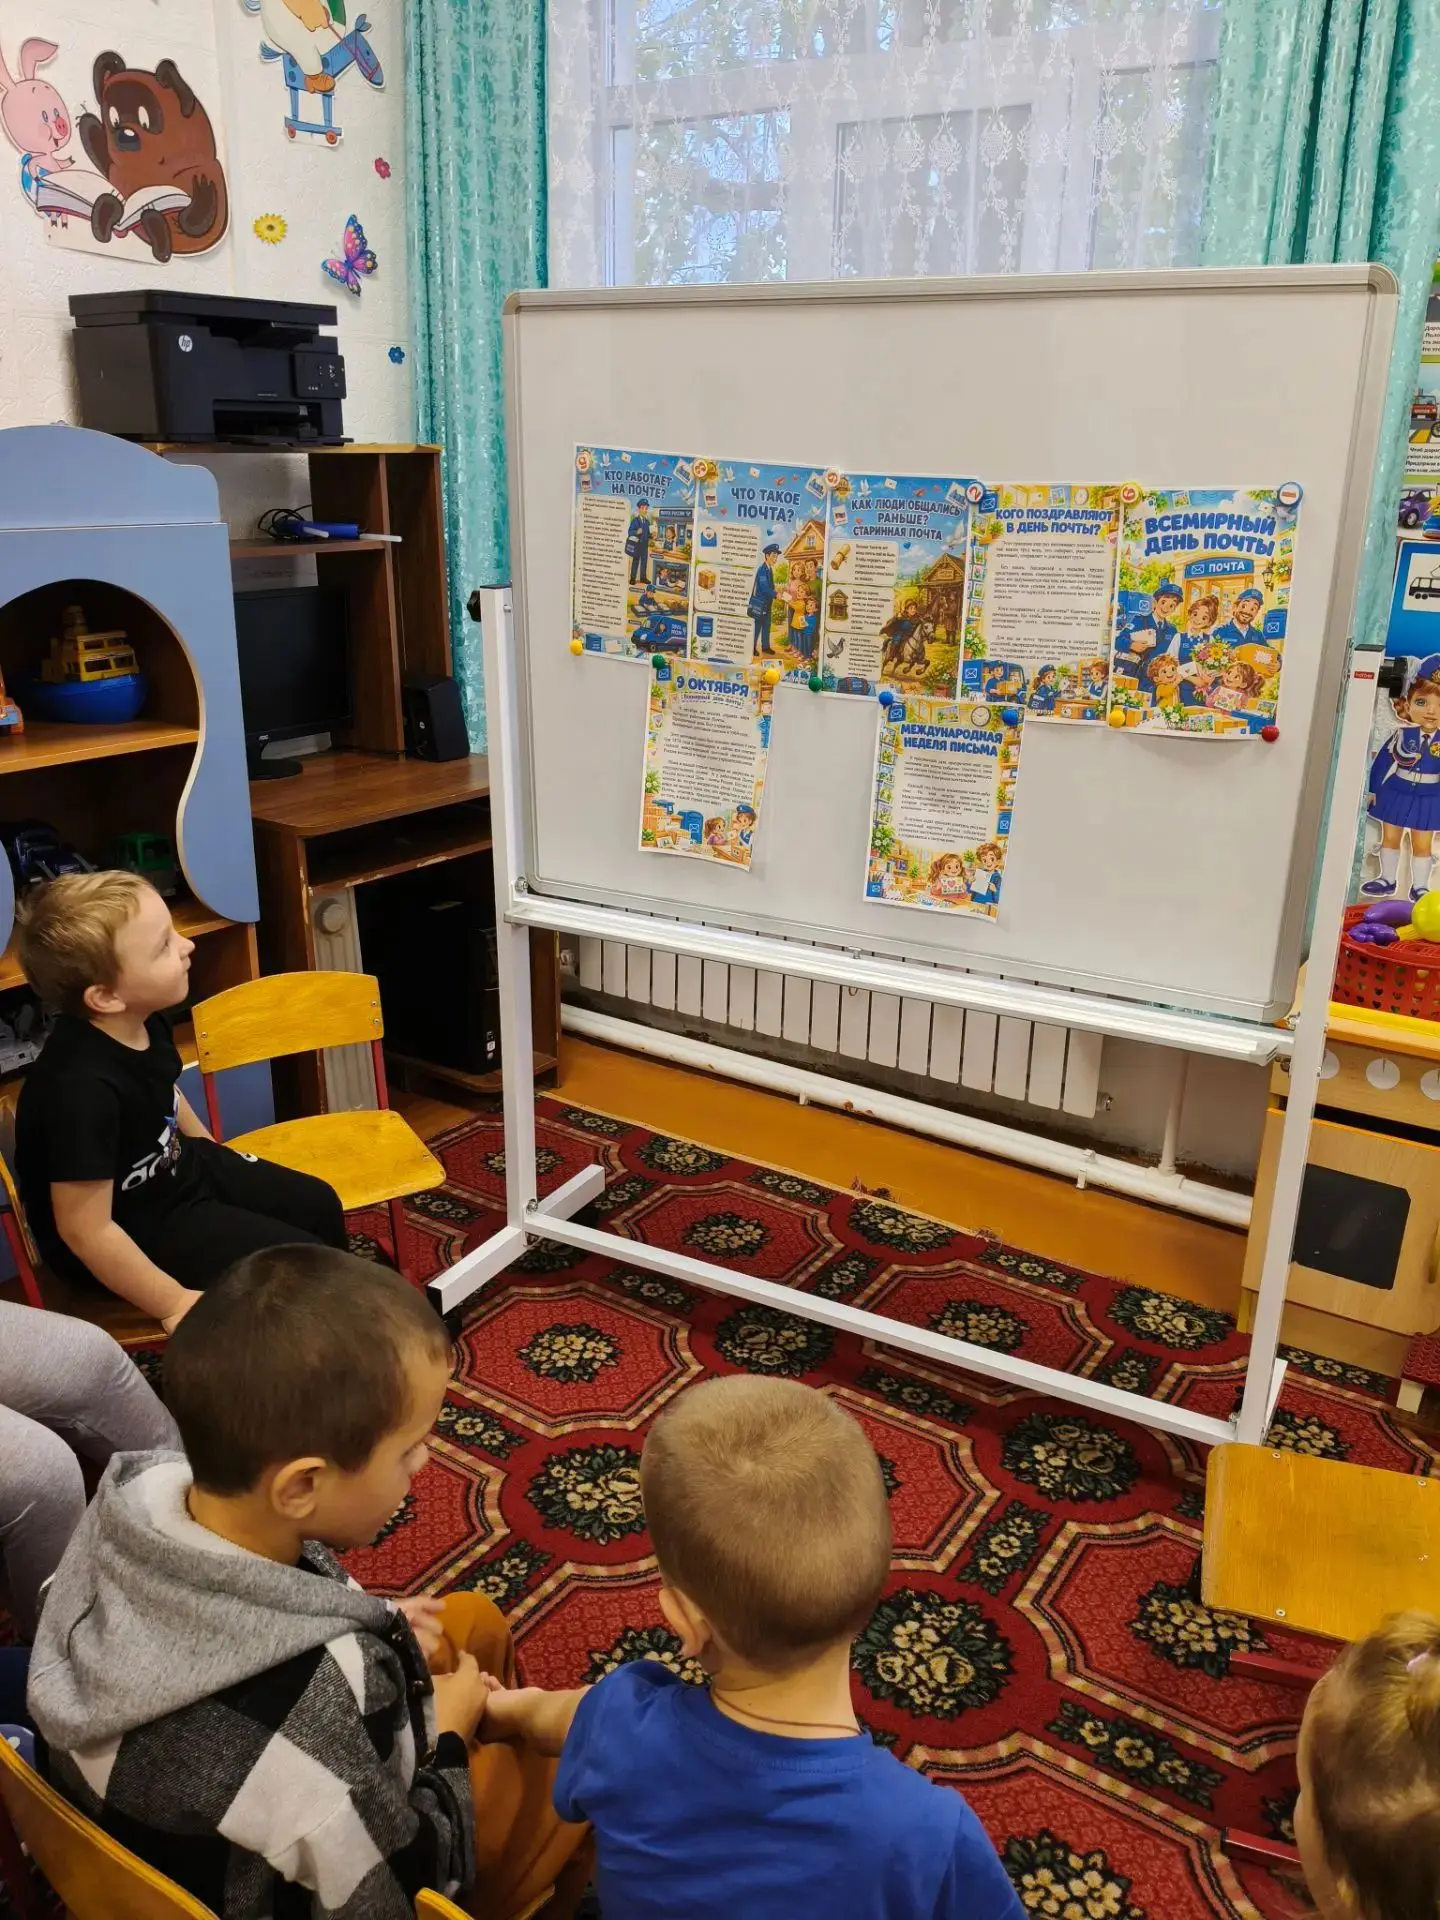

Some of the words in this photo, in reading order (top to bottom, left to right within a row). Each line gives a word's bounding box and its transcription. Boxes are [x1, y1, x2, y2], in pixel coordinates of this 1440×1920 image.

[179, 335, 192, 352] hp
[605, 470, 622, 481] КТО
[625, 471, 672, 486] РАБОТАЕТ
[612, 484, 625, 494] НА
[628, 485, 666, 499] ПОЧТЕ?
[732, 487, 756, 500] ЧТО
[759, 488, 800, 506] ТАКОЕ
[738, 504, 794, 522] ПОЧТА?
[852, 499, 872, 510] КАК
[874, 499, 905, 510] ЛЮДИ
[908, 501, 961, 516] ОБЩАЛИСЬ
[996, 508, 1024, 520] КОГО
[1026, 509, 1112, 522] ПОЗДРАВЛЯЮТ
[878, 513, 929, 526] РАНЬШЕ?
[1144, 512, 1276, 536] ВСЕМИРНЫЙ
[853, 526, 906, 537] СТАРИННАЯ
[910, 527, 942, 540] ПОЧТА
[1006, 522, 1014, 533] В
[1017, 522, 1049, 534] ДЕНЬ
[1051, 523, 1101, 535] ПОЧТЫ?
[1144, 533, 1199, 557] ДЕНЬ
[1204, 534, 1276, 557] ПОЧТЫ
[1208, 560, 1245, 572] ПОЧТА
[676, 676, 684, 688] 9
[688, 678, 749, 697] ОКТЯБРЯ
[900, 724, 1003, 744] МЕЖДУНАРОДНАЯ
[904, 737, 947, 752] НЕДЕЛЯ
[950, 739, 998, 757] ПИСЬМА
